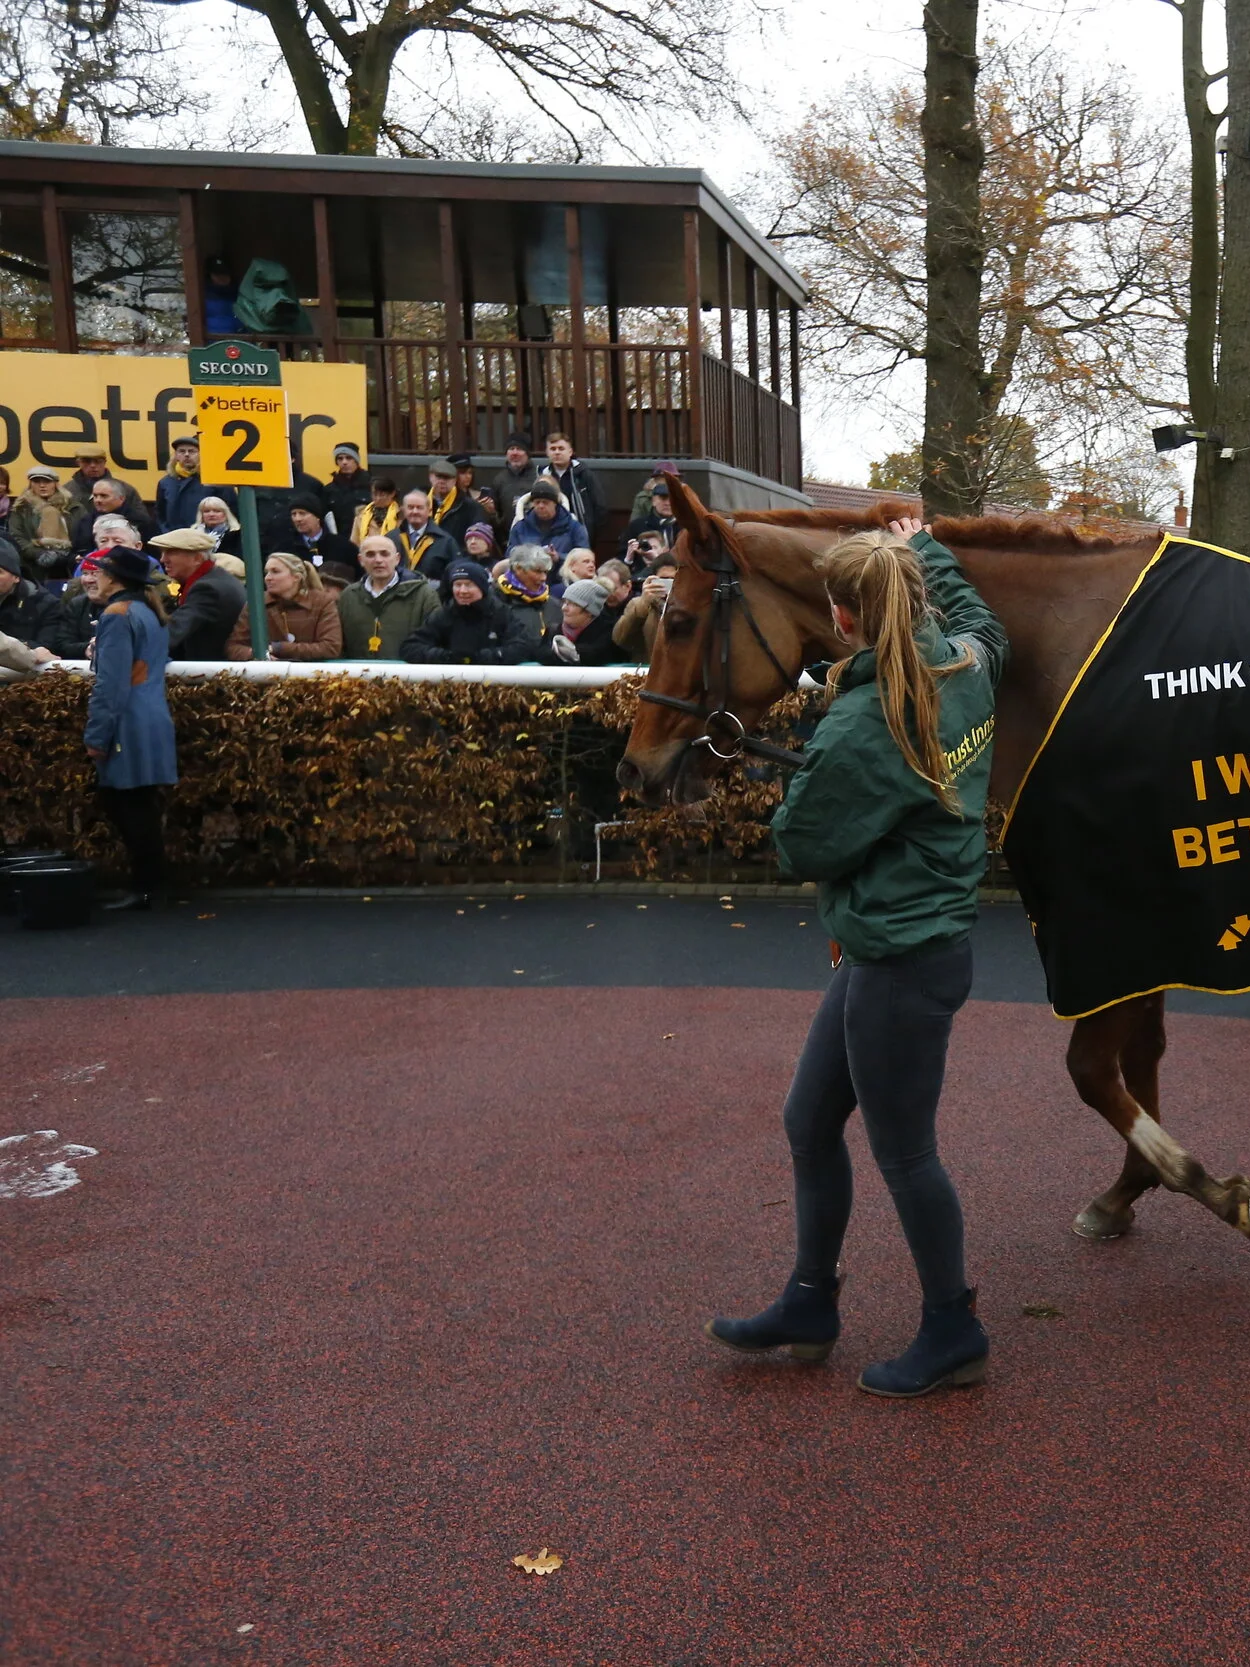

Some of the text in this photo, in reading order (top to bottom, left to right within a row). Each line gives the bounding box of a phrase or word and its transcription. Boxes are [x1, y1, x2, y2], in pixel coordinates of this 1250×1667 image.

[199, 361, 269, 376] SECOND
[217, 396, 282, 413] betfair
[0, 385, 337, 471] etfr
[221, 419, 264, 472] 2
[1143, 661, 1246, 700] THINK
[943, 733, 974, 770] rust
[1191, 760, 1207, 801] I
